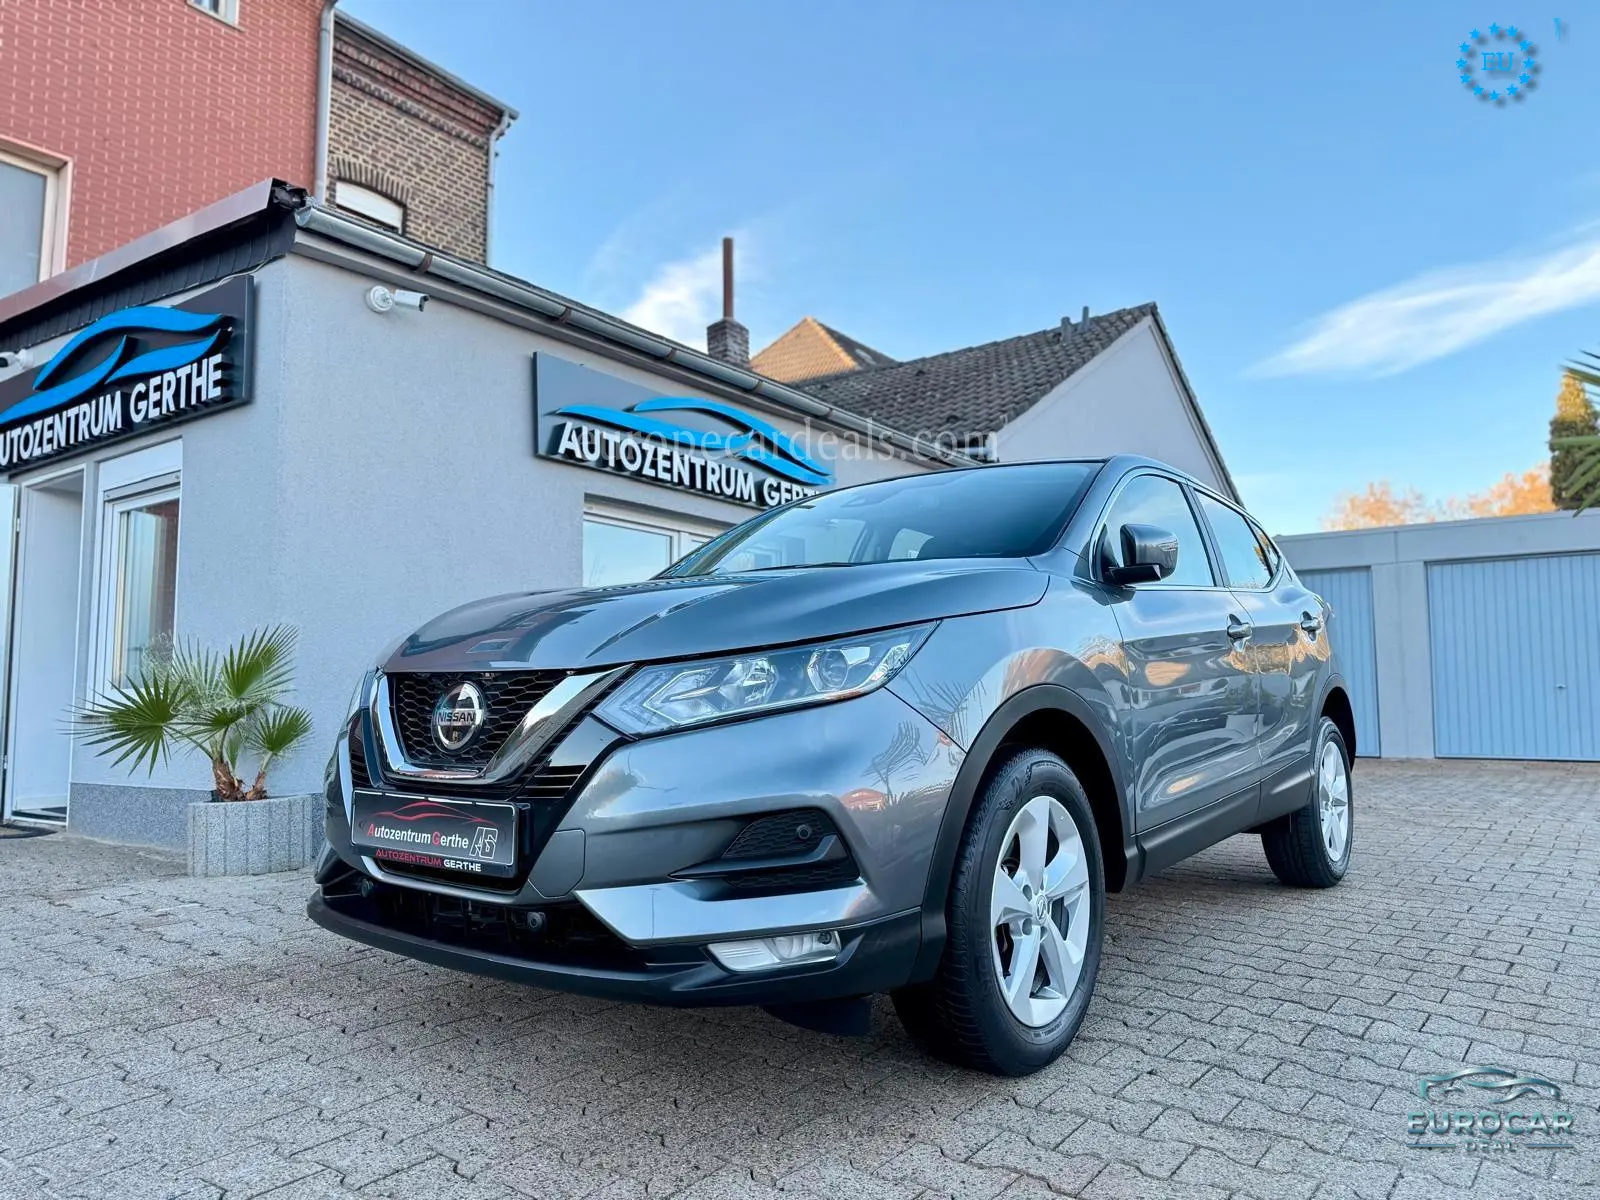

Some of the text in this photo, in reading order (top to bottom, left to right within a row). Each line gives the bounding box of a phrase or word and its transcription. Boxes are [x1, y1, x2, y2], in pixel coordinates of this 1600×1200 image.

[0, 353, 223, 467] UTOZENTRUM GERTHE
[557, 421, 820, 507] AUTOZENTRUM GER
[437, 711, 475, 722] NISSAN
[367, 823, 469, 849] Autozentrum Gerthe
[375, 848, 482, 872] AUTOZENTRUM GERTHE
